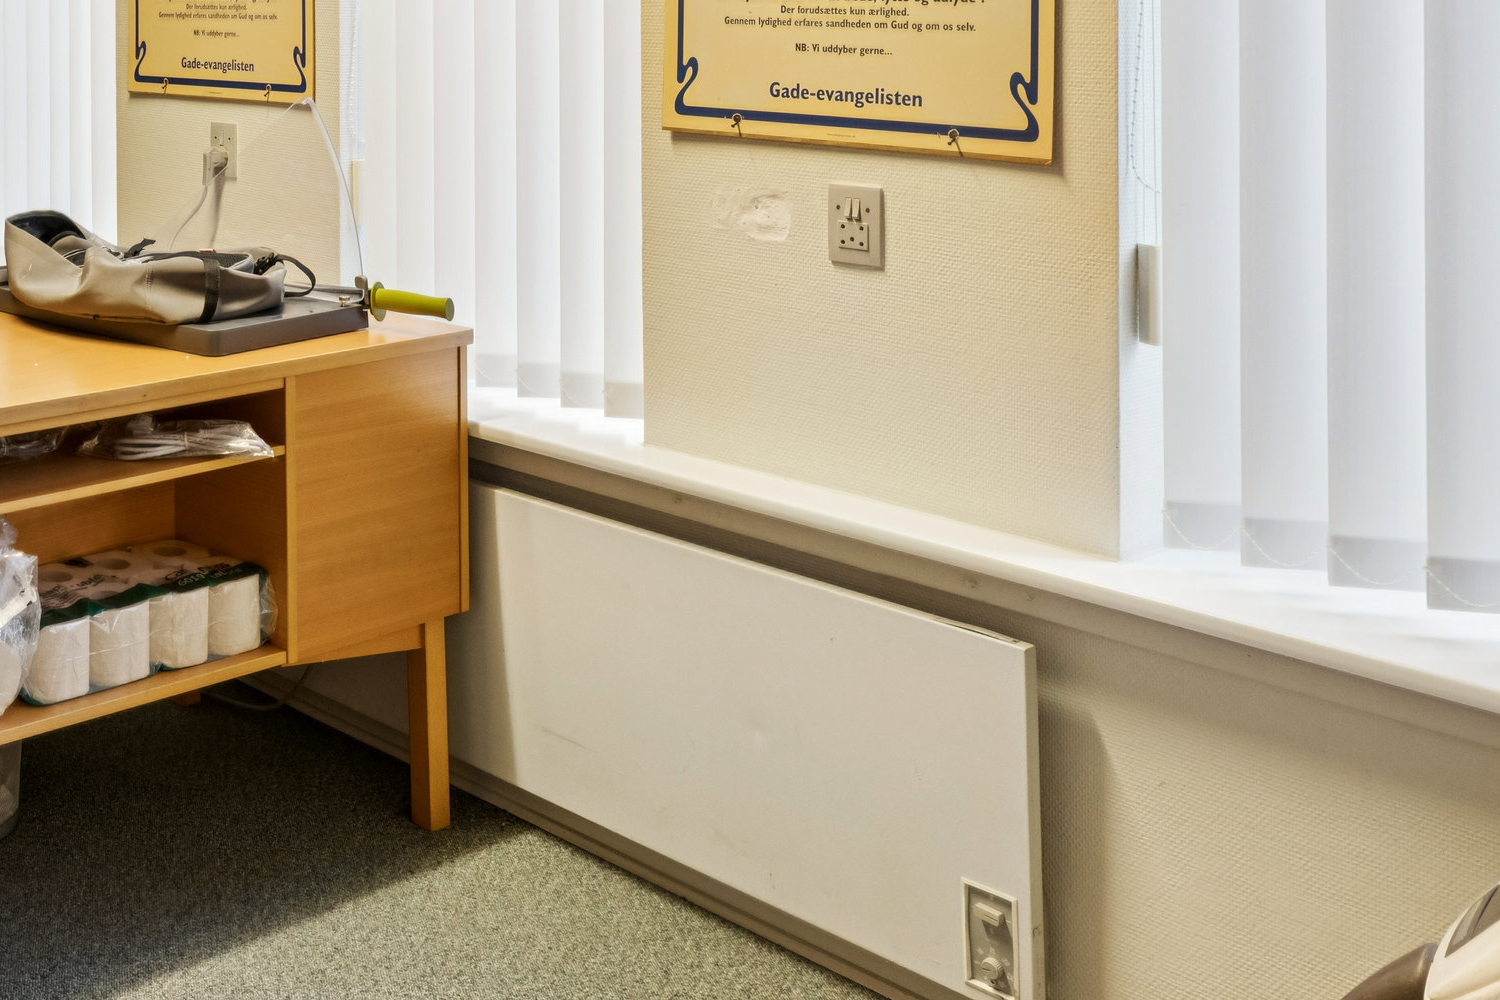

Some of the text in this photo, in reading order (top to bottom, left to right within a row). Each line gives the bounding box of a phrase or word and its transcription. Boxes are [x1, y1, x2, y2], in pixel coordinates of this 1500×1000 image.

[795, 42, 810, 52] NB:
[811, 43, 820, 53] Vi
[822, 43, 858, 56] uddyber
[180, 56, 255, 74] Gade-evangelisten
[769, 81, 923, 109] Gade-evangelisten
